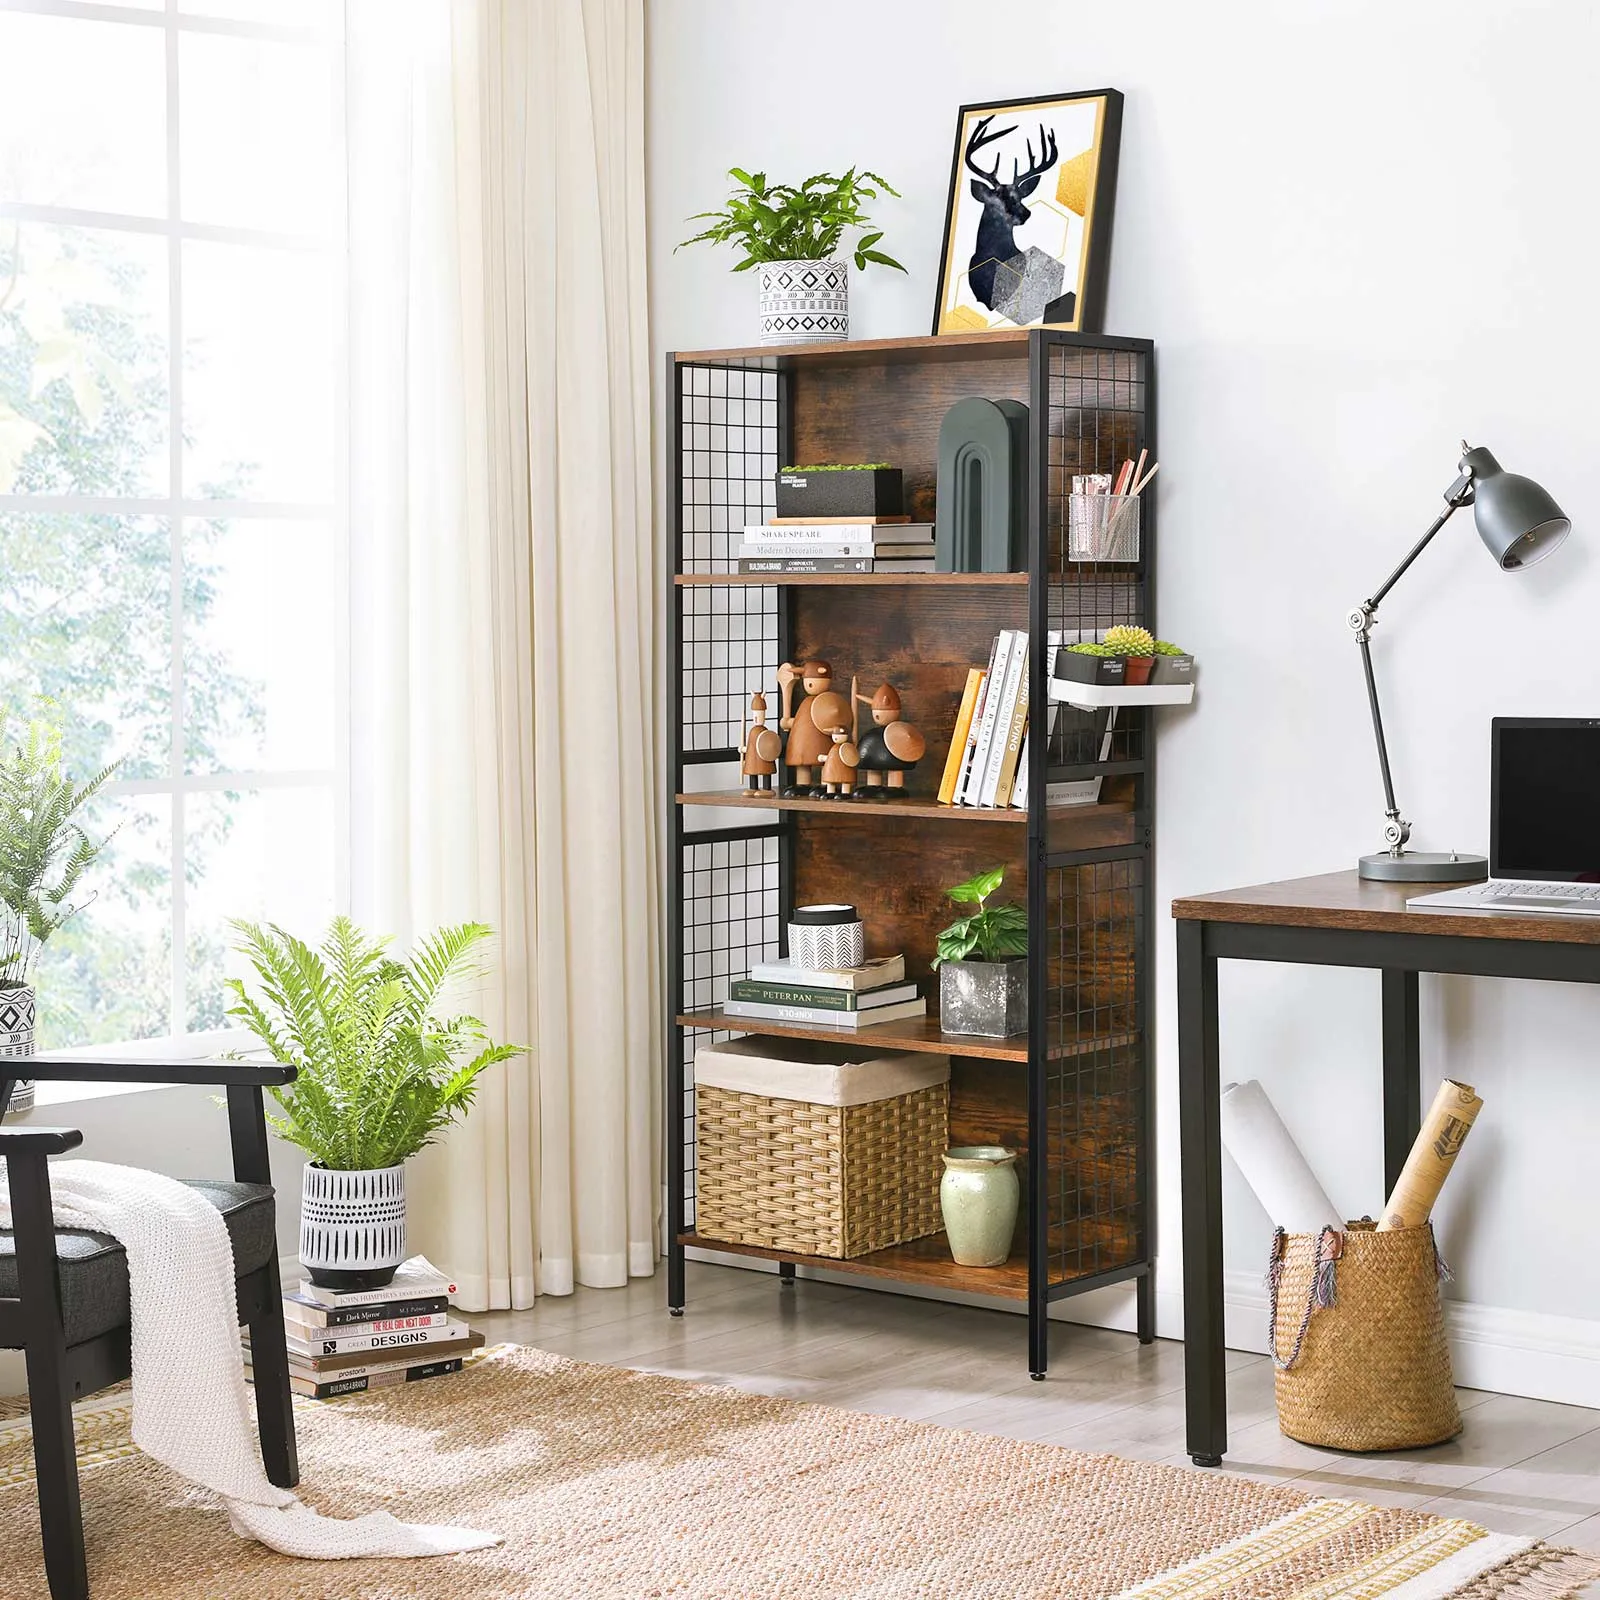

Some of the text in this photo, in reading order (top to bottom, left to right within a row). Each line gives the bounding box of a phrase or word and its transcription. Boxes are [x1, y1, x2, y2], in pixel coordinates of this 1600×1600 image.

[761, 530, 822, 538] SHAKESPEARE
[756, 546, 824, 555] Modern Decoration
[1009, 713, 1024, 752] LIVING
[763, 990, 791, 1000] PETER
[793, 991, 812, 1002] PAN
[340, 1294, 359, 1305] JOHN
[345, 1311, 380, 1322] Dark Mirror
[372, 1321, 382, 1332] THE
[381, 1320, 394, 1331] REAL
[394, 1319, 405, 1330] GIRL
[405, 1318, 418, 1328] NEXT
[418, 1316, 432, 1327] DOOR
[347, 1340, 367, 1348] GREAT
[371, 1332, 428, 1347] DESIGNS
[338, 1366, 367, 1379] prostoria
